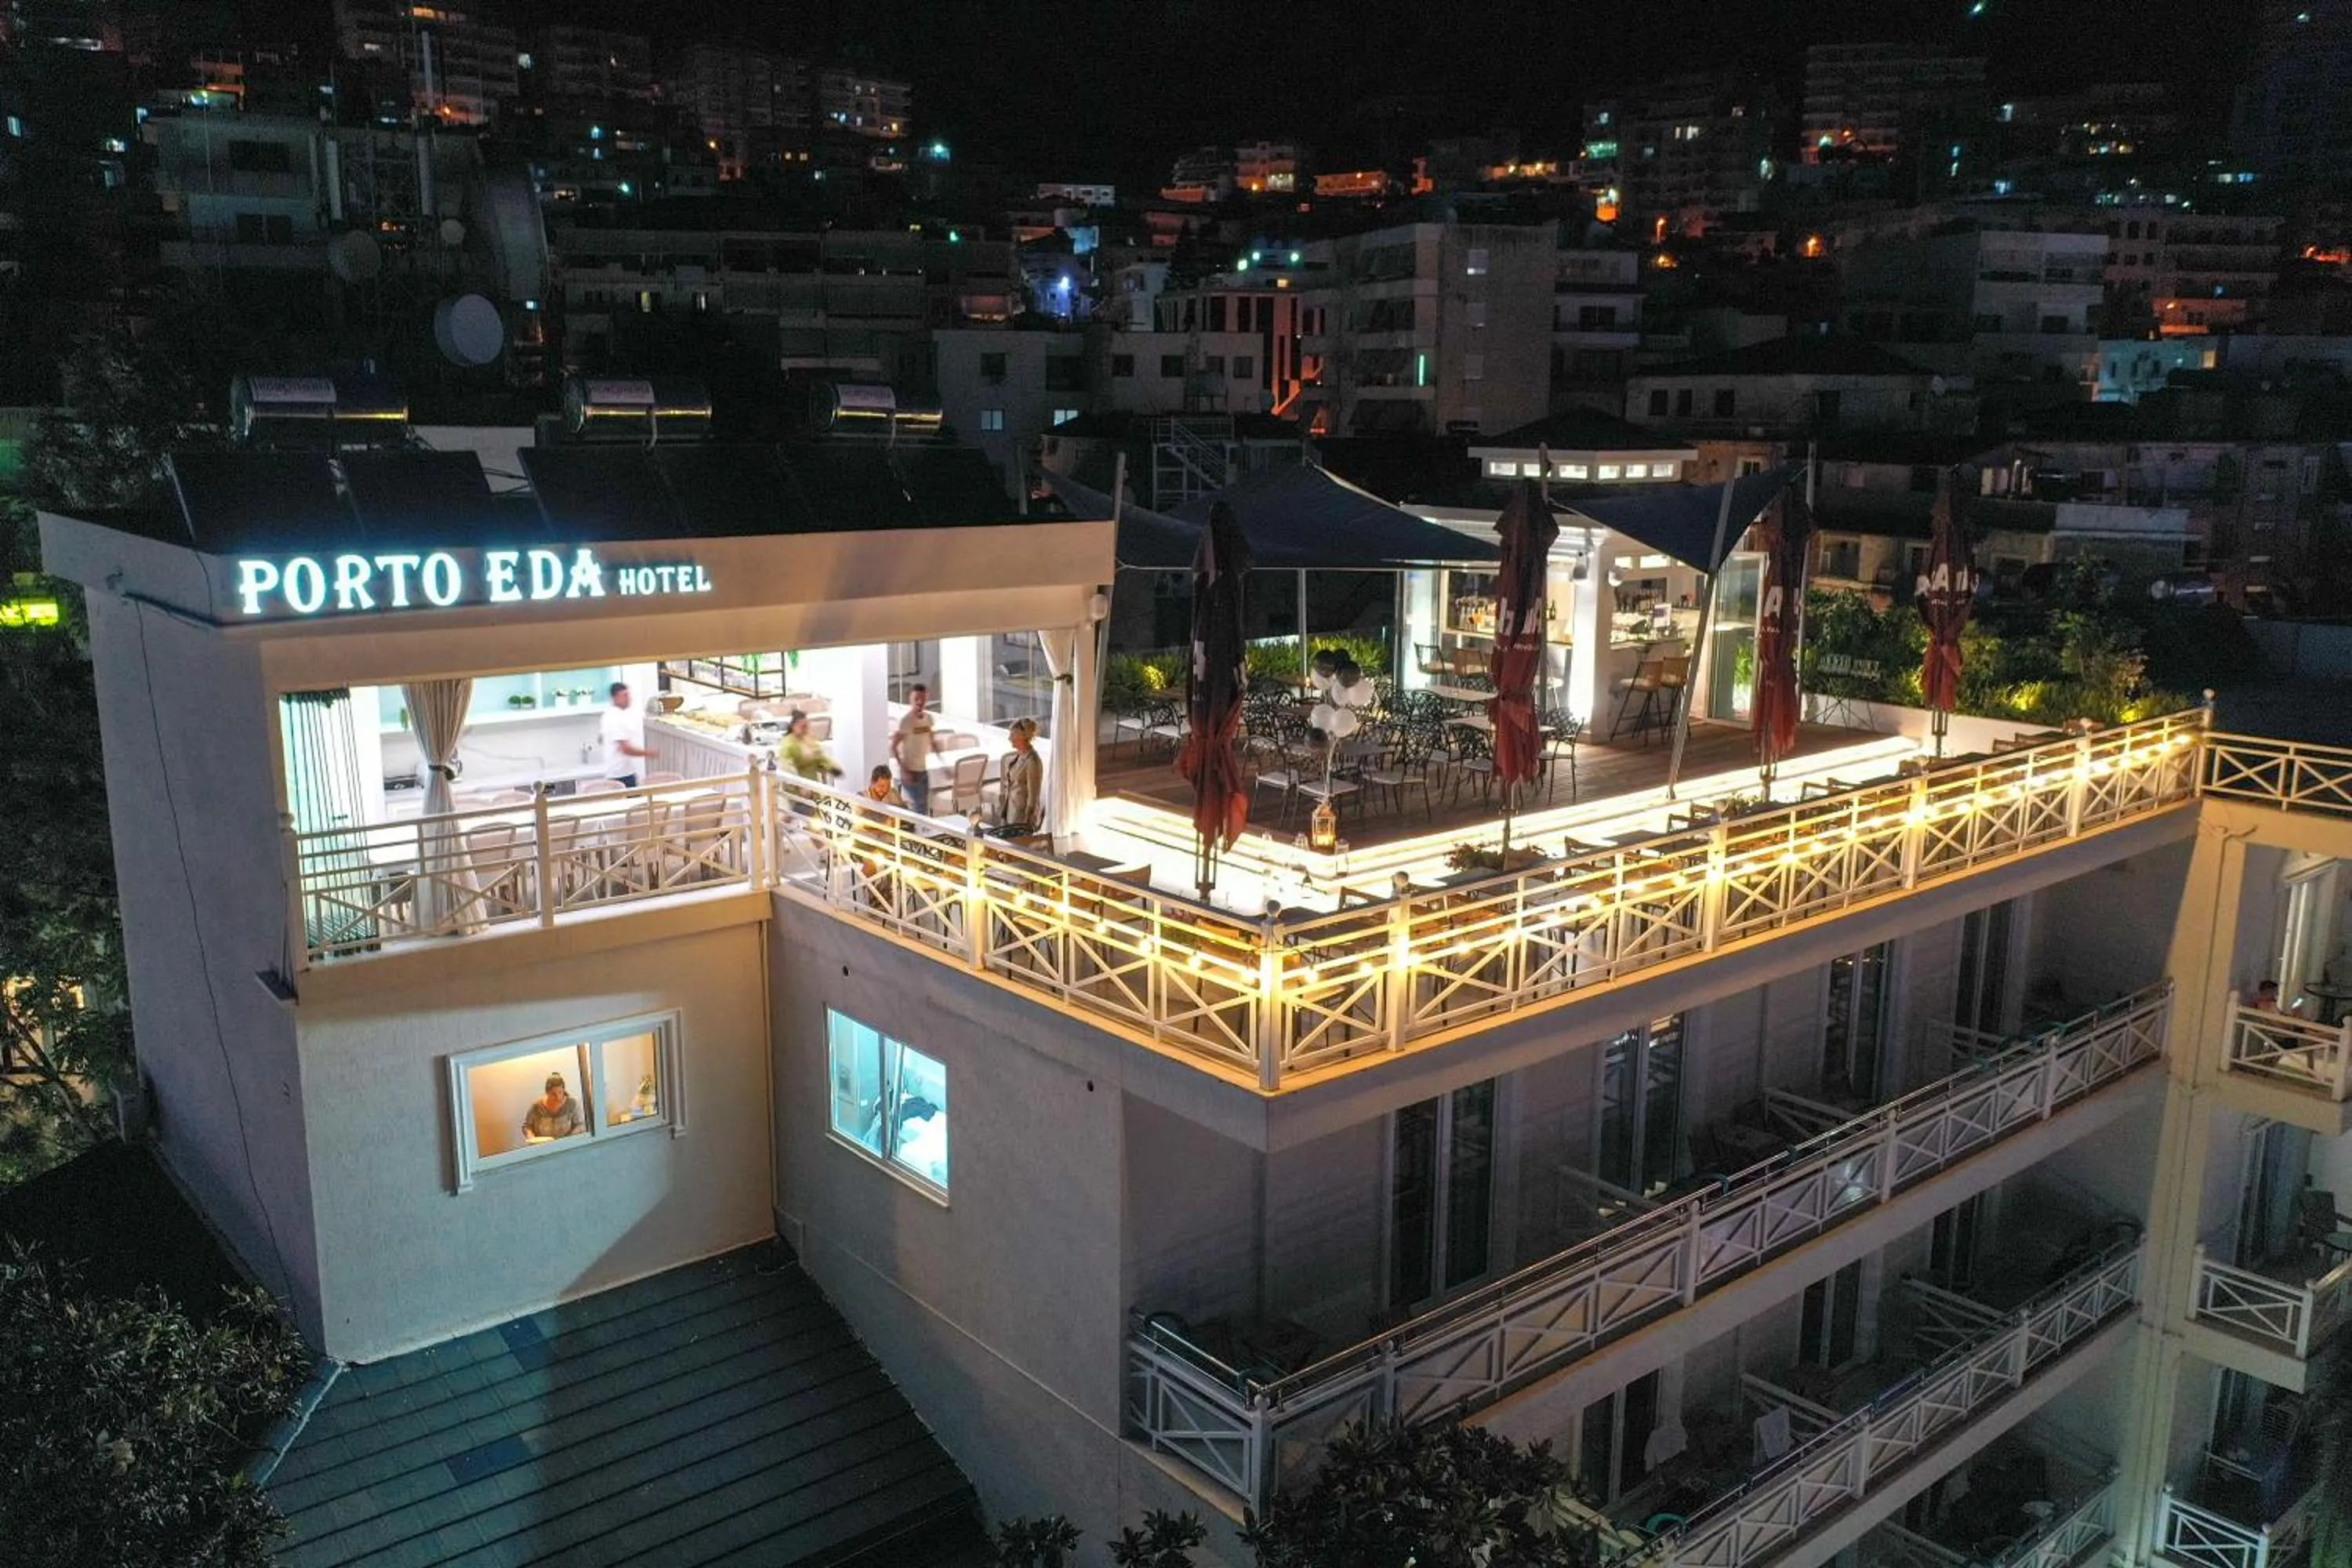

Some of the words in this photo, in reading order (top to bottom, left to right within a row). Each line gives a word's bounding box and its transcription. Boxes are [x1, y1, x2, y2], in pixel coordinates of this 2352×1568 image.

[238, 552, 463, 614] PORTO
[485, 548, 606, 602] EDA
[619, 565, 712, 596] HOTEL
